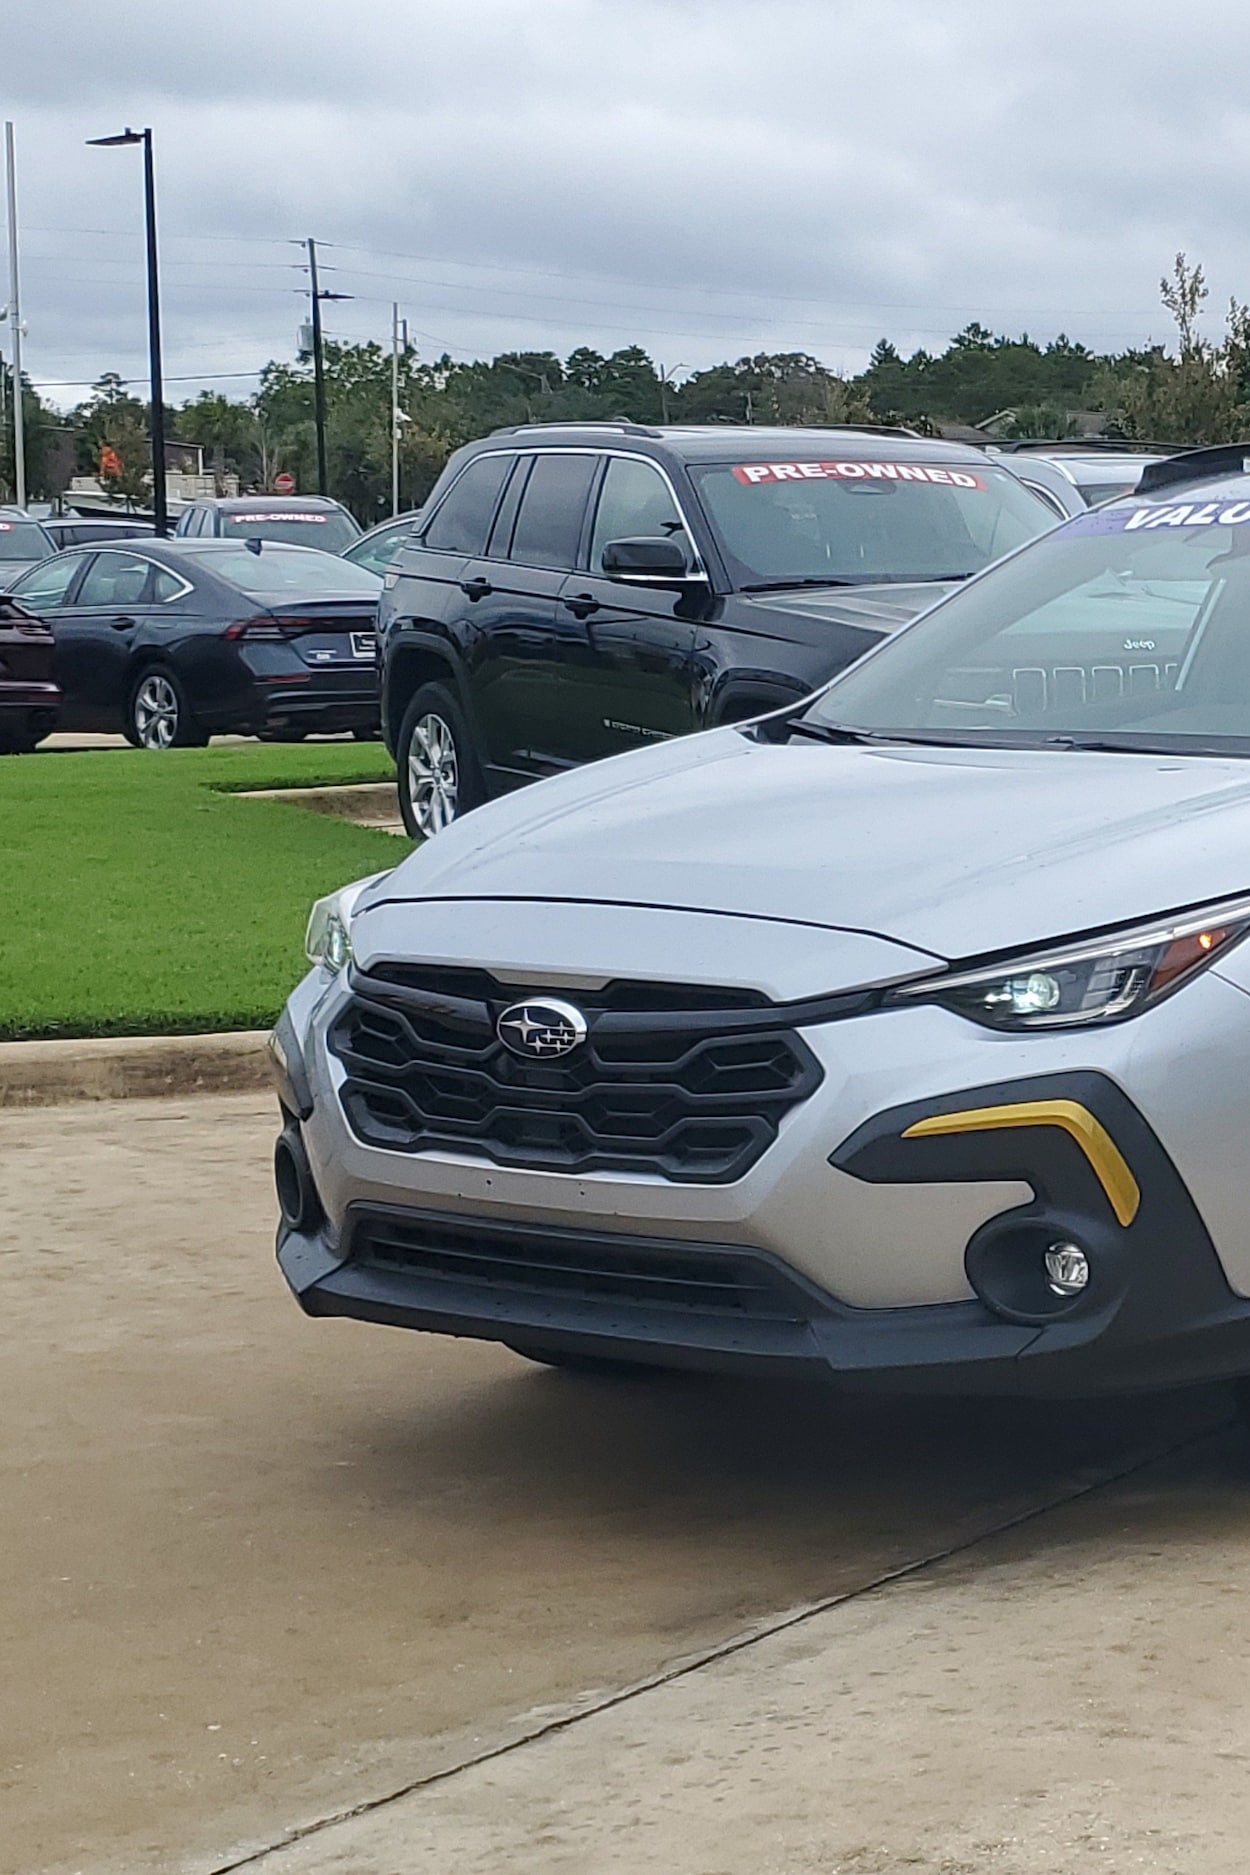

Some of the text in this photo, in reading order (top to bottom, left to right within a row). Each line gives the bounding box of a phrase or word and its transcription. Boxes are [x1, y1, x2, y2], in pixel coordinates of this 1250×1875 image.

[743, 462, 977, 488] PRE-OWNED
[235, 513, 326, 523] PRE-OWNED
[1123, 639, 1156, 651] Jeep
